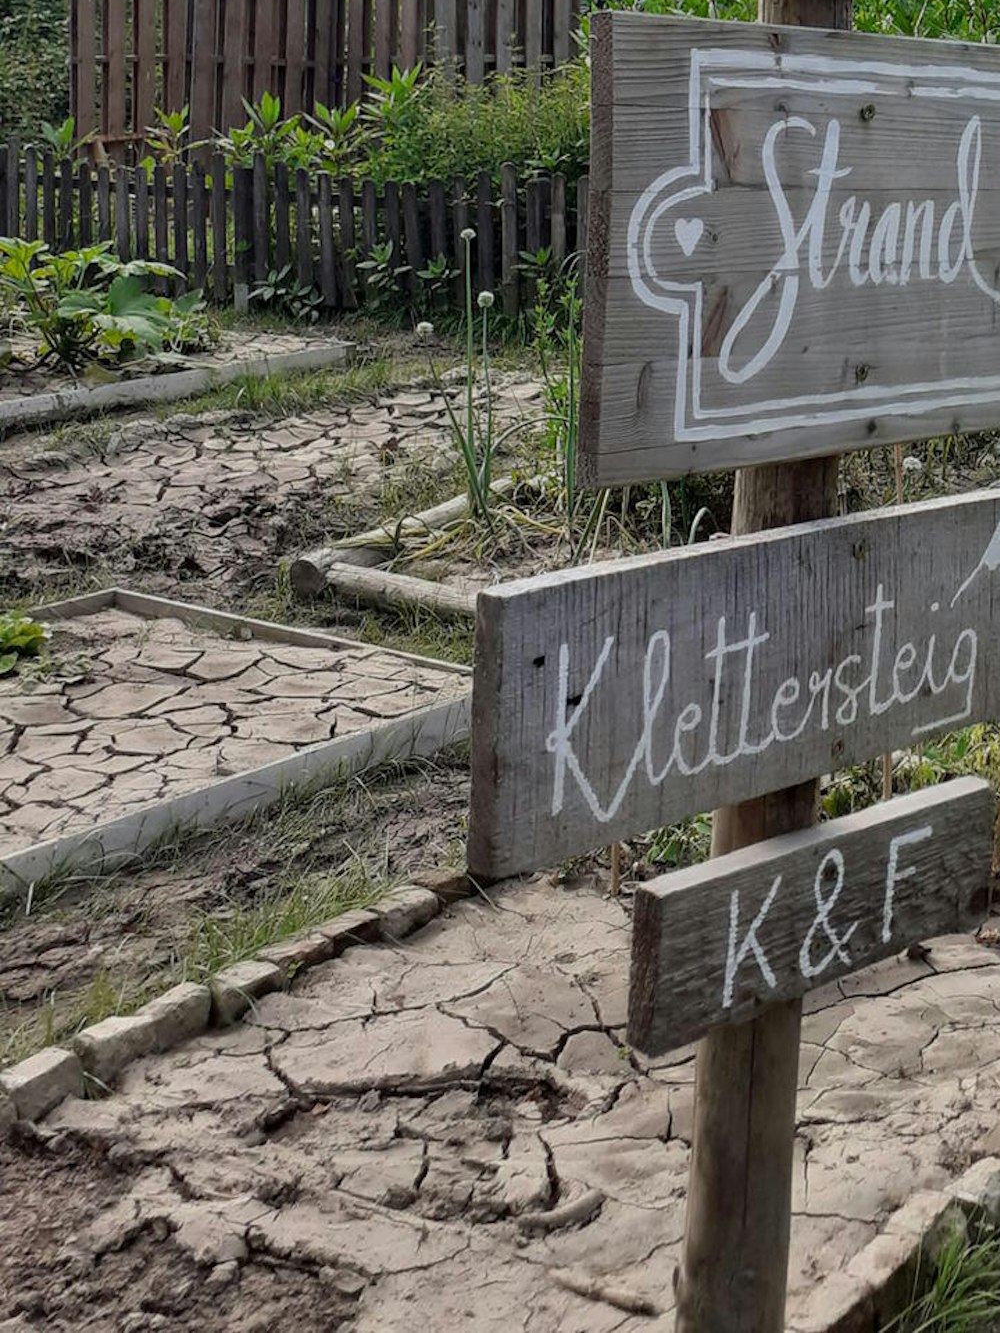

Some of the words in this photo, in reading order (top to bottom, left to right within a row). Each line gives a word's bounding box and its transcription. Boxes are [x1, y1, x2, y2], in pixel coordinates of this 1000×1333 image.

[545, 582, 978, 822] Klettersteig
[722, 875, 784, 1009] K
[801, 849, 860, 979] &
[882, 825, 933, 944] F
